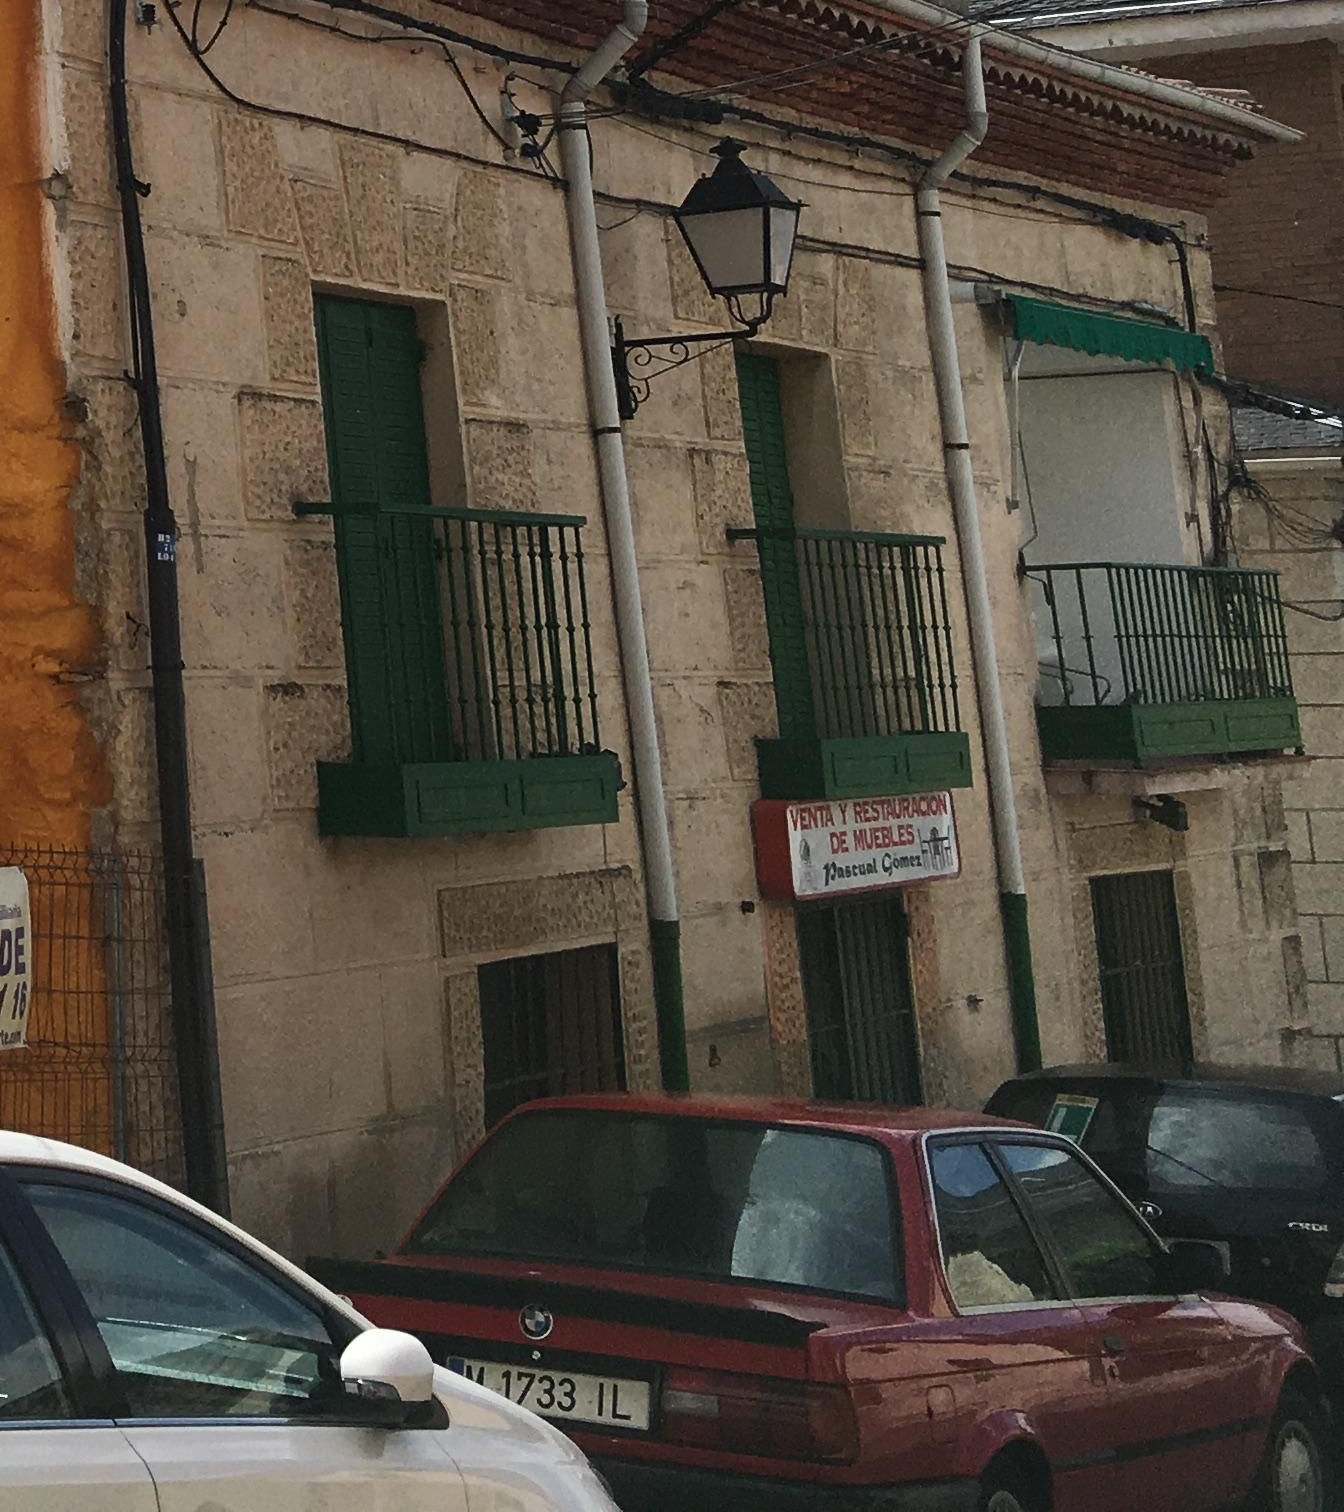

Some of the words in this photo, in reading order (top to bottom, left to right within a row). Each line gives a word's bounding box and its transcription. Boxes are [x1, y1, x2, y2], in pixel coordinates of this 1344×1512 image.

[789, 806, 834, 832] VENTA
[839, 803, 849, 825] Y
[829, 831, 850, 854] DE
[853, 823, 915, 852] MUEBLES
[822, 857, 878, 886] Pascual
[501, 1370, 577, 1412] 1733
[598, 1382, 632, 1421] IL
